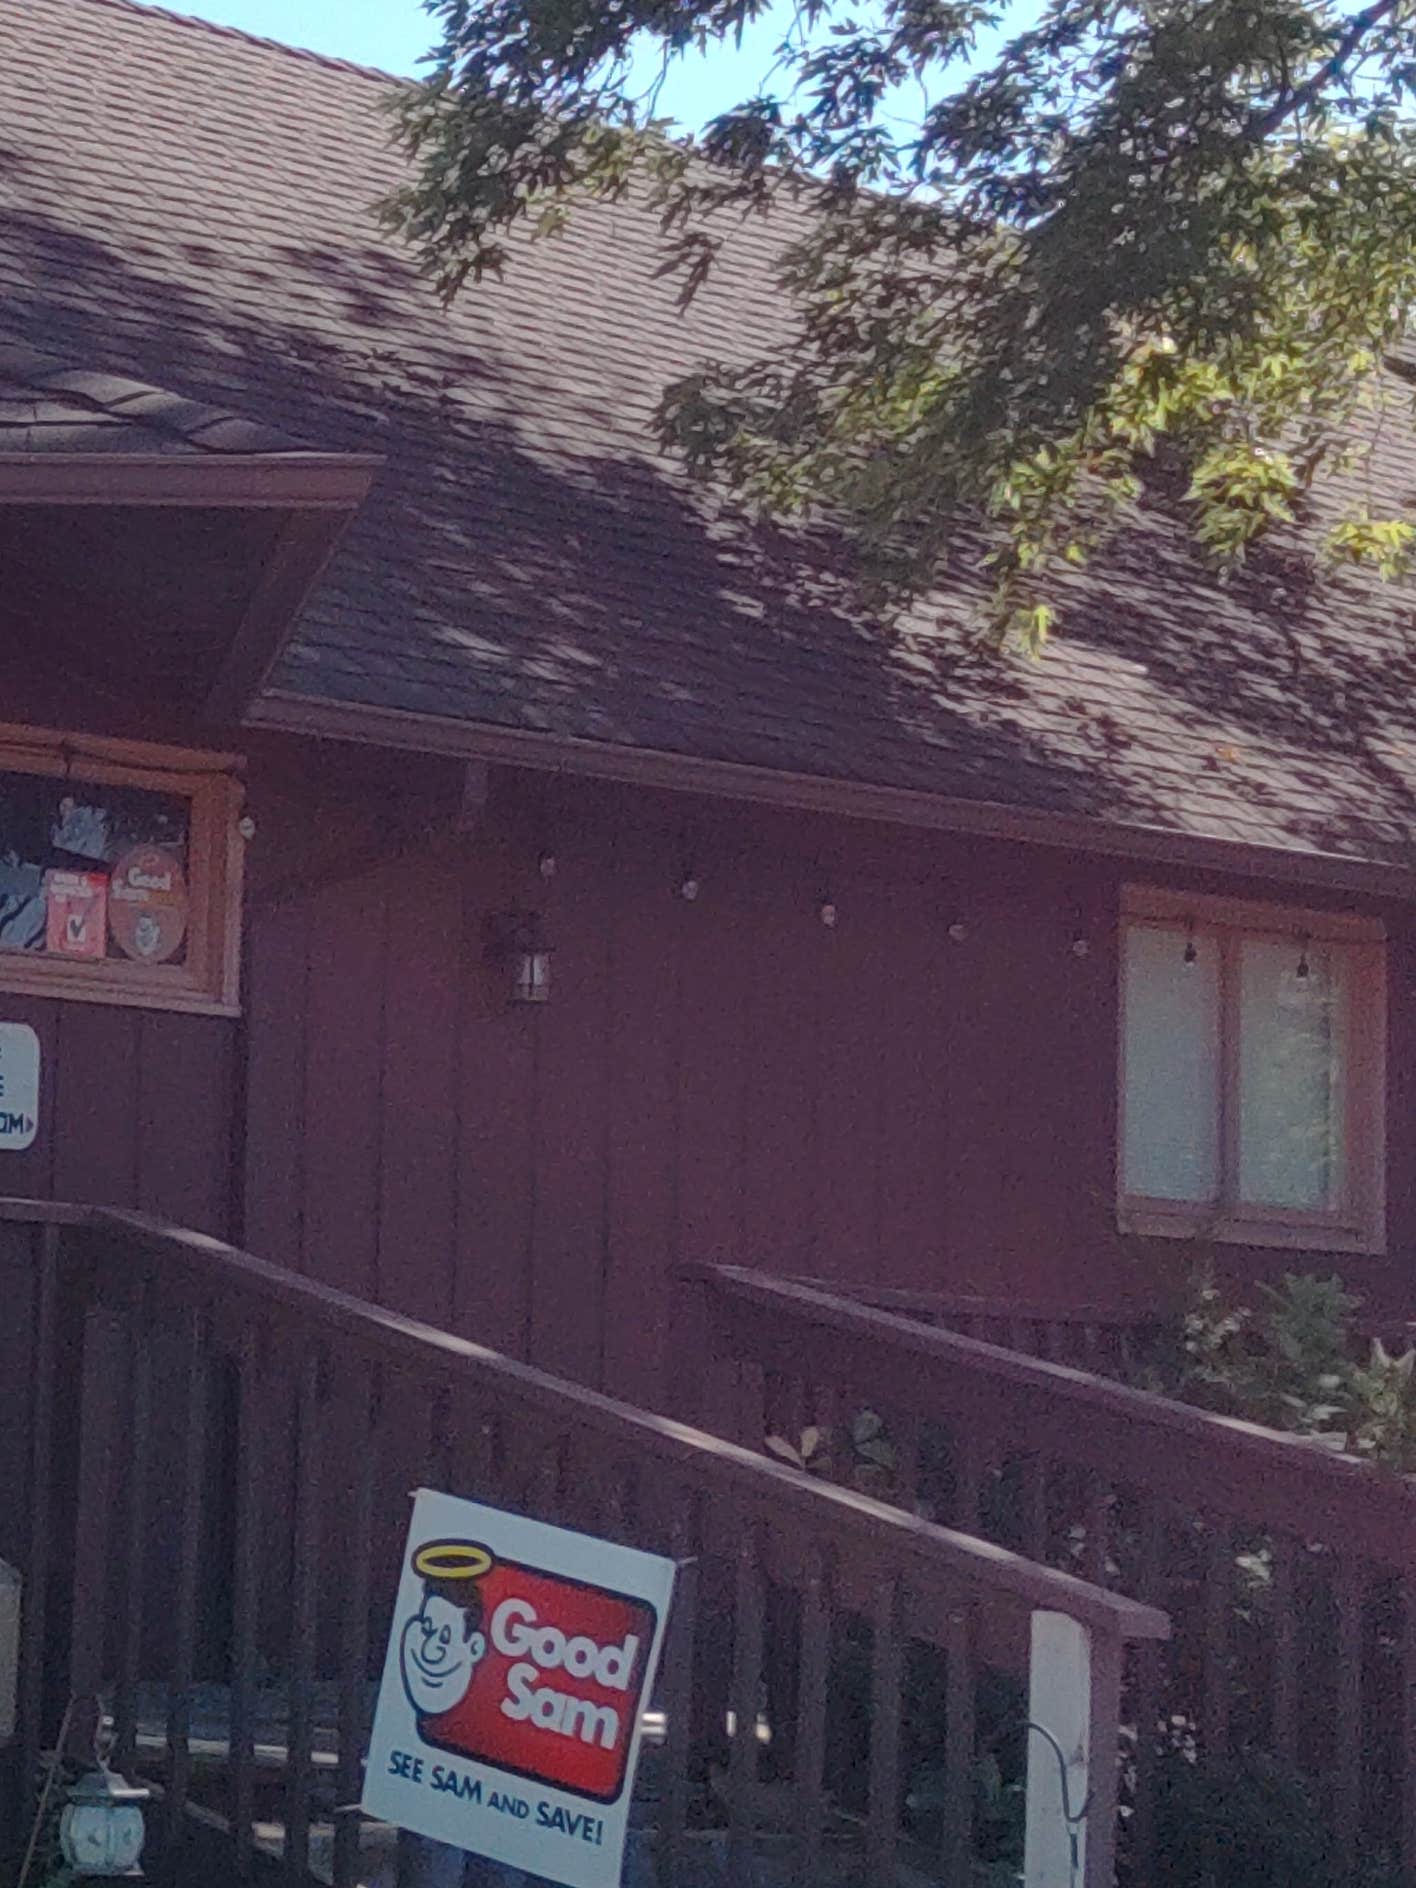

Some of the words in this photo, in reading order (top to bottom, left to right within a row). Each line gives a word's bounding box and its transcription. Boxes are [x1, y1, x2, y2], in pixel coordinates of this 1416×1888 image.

[490, 1597, 639, 1691] Good
[500, 1662, 620, 1750] Sam
[388, 1750, 424, 1783] SEE
[430, 1765, 482, 1805] SAM
[487, 1791, 530, 1820] AND
[536, 1801, 604, 1846] SAVE!
